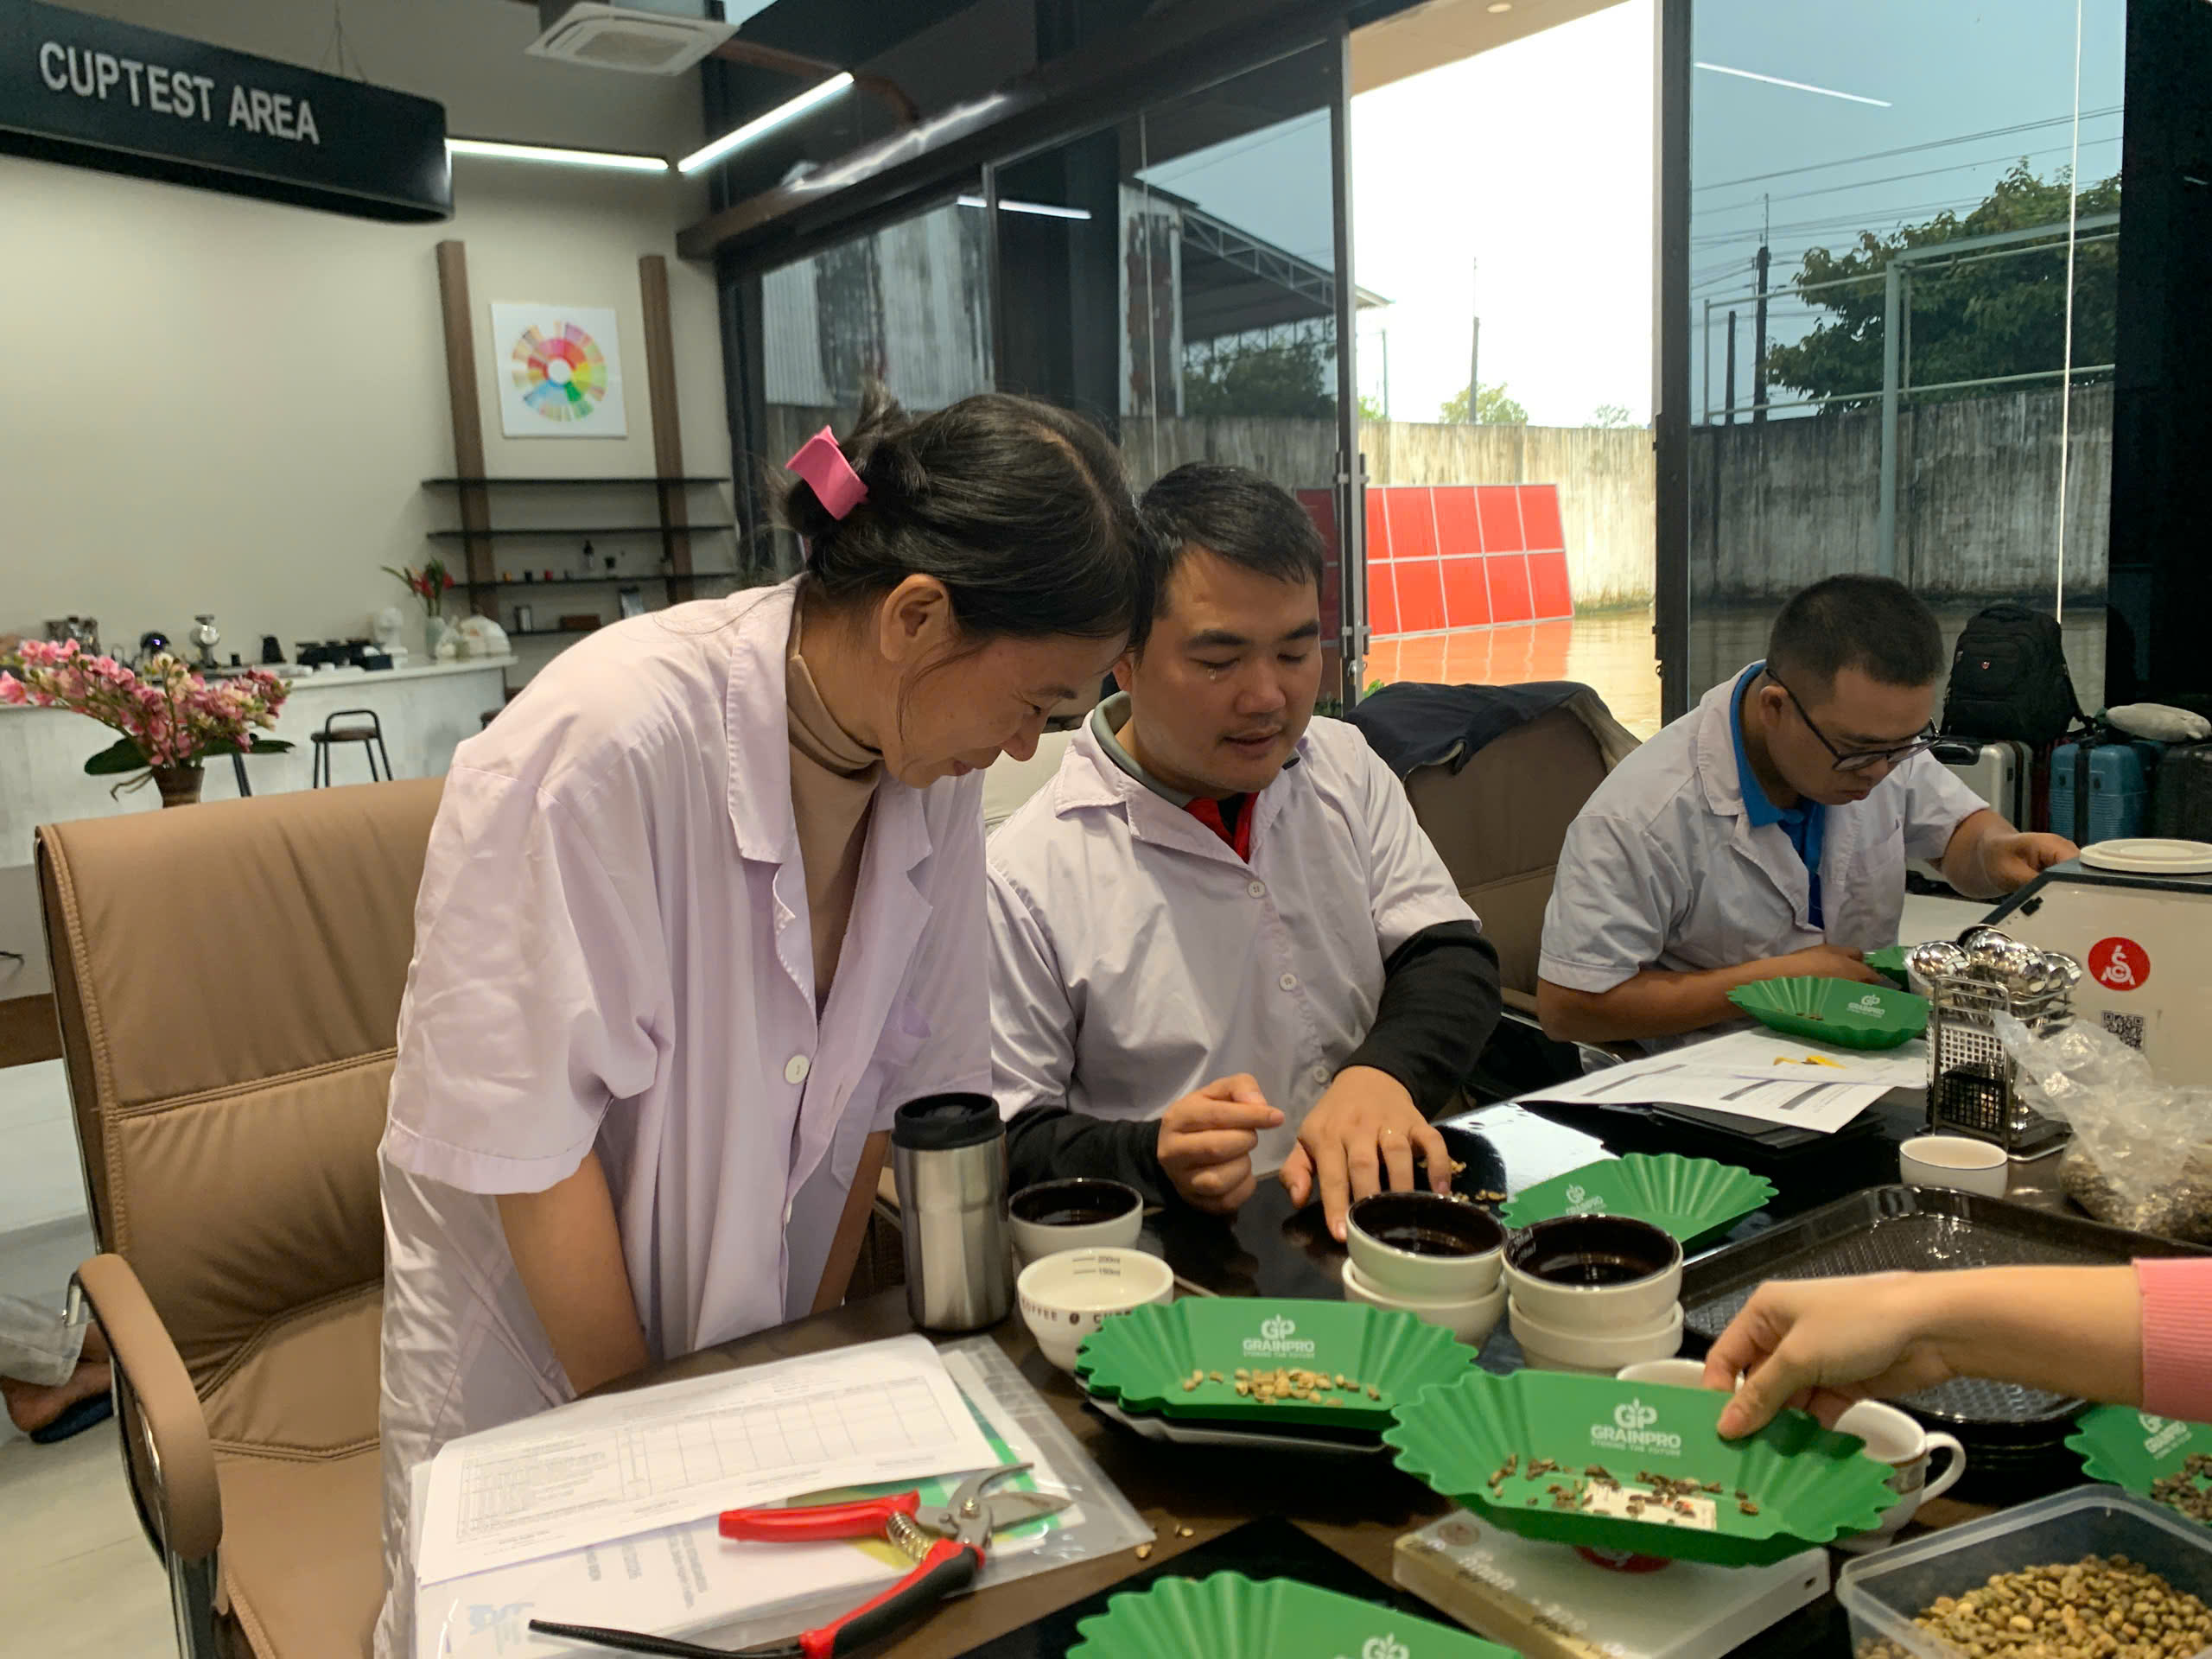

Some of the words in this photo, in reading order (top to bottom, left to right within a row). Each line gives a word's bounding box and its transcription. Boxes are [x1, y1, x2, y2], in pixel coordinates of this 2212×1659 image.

[40, 41, 214, 122] CUPTEST
[228, 85, 321, 145] AREA
[1243, 1339, 1316, 1352] GRAINPRO
[1591, 1424, 1681, 1449] GRAINPRO
